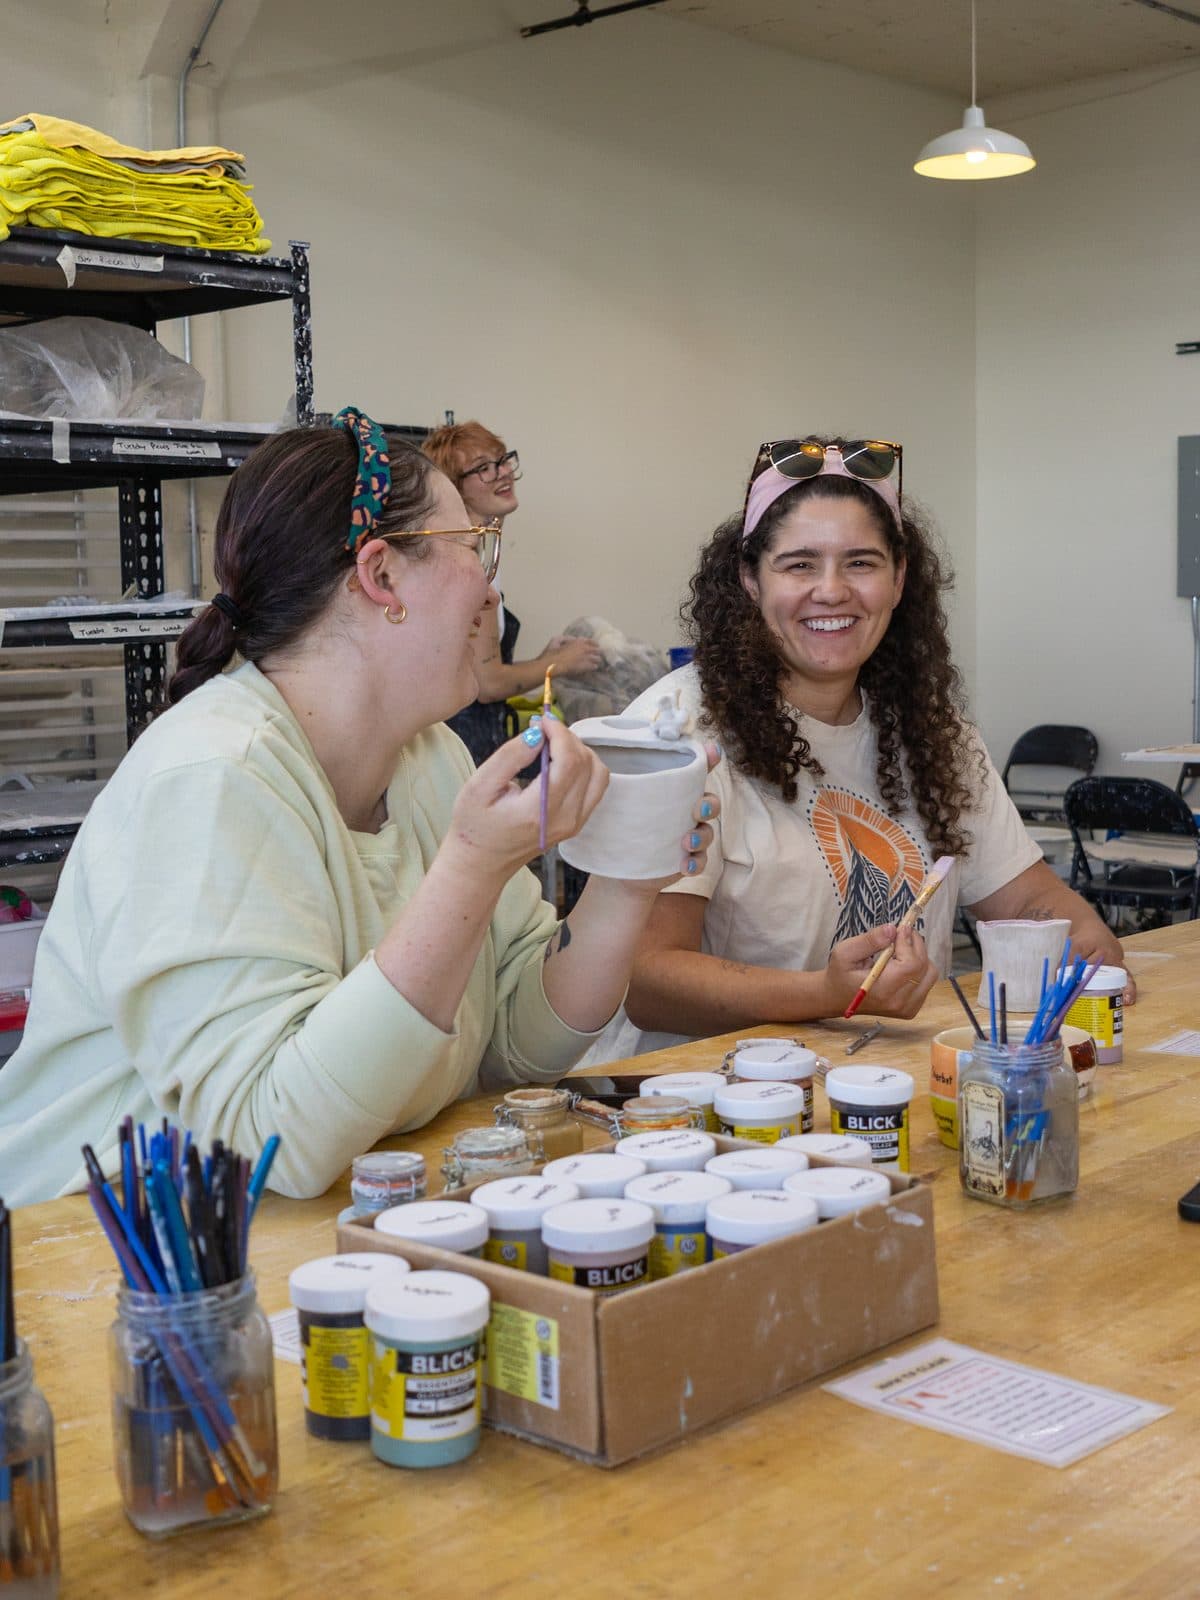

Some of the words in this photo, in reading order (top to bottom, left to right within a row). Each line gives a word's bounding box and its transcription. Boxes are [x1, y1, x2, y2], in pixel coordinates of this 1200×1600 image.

[847, 1115, 896, 1130] BLICK
[587, 1259, 644, 1287] BLICK
[411, 1344, 475, 1374] BLICK
